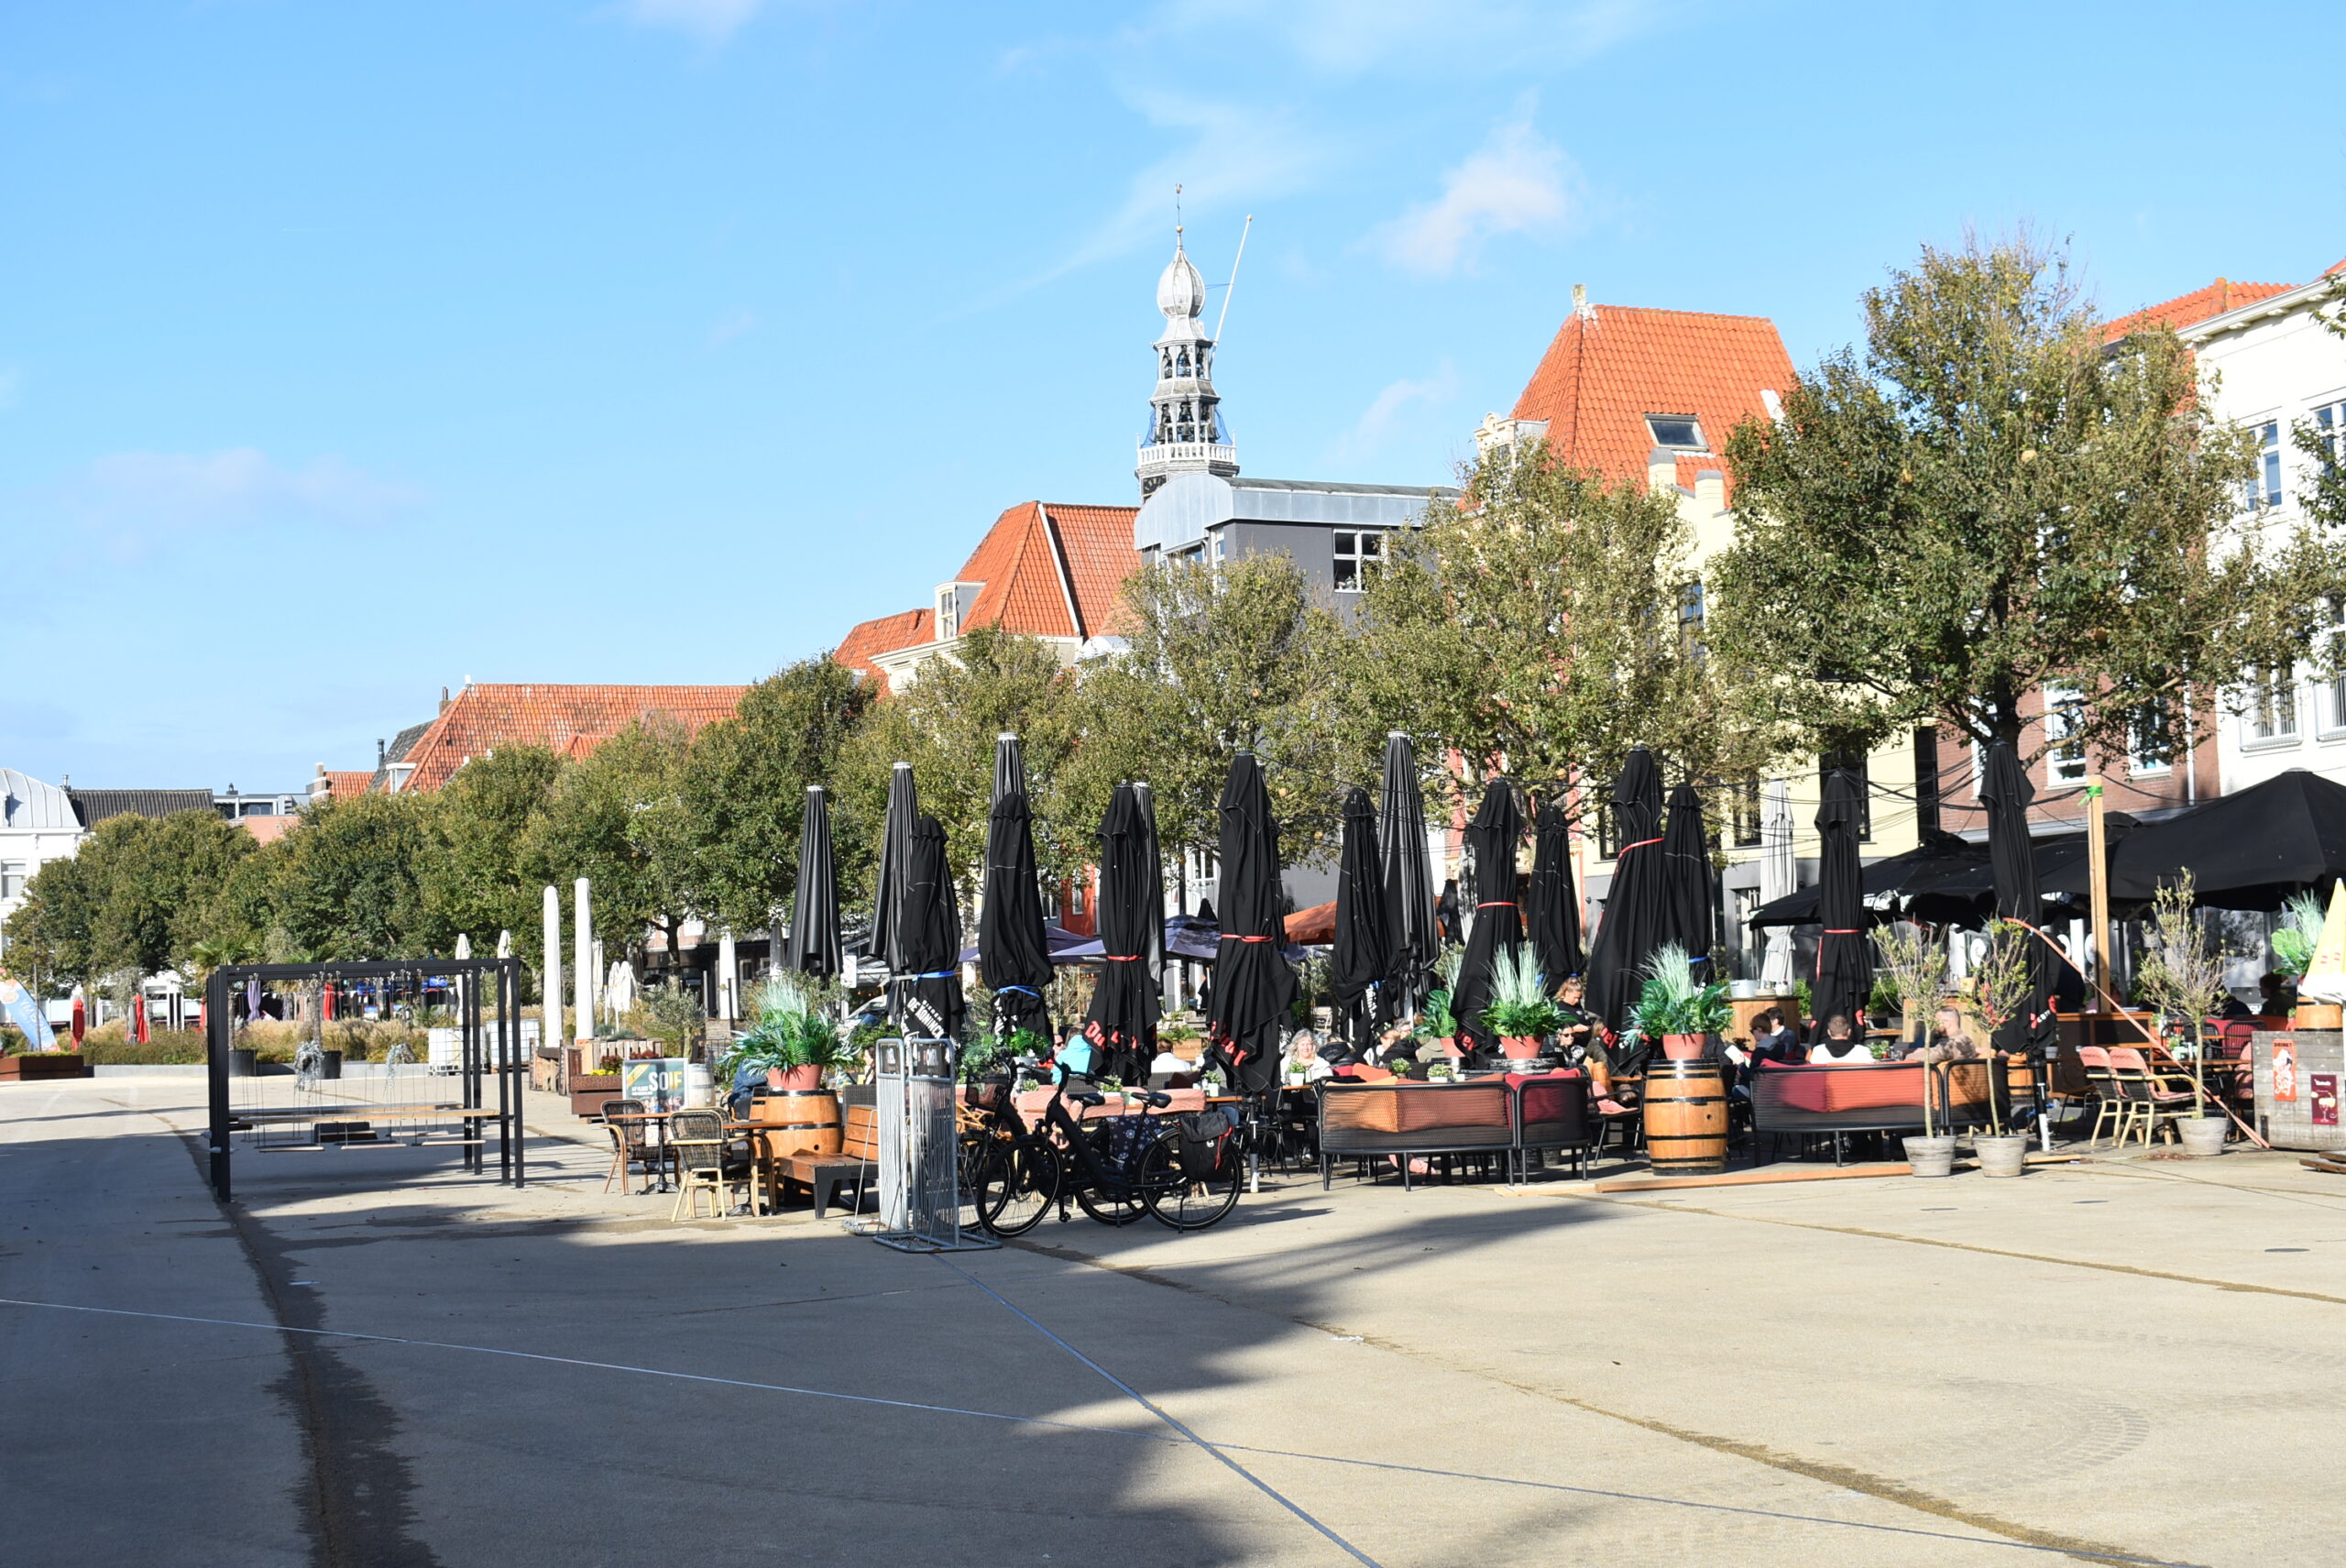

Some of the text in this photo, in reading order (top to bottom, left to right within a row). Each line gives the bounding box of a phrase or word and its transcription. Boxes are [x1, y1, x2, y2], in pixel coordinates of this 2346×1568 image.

[906, 997, 921, 1013] DE
[915, 1004, 945, 1039] KONINCK
[648, 1070, 683, 1091] SOIF
